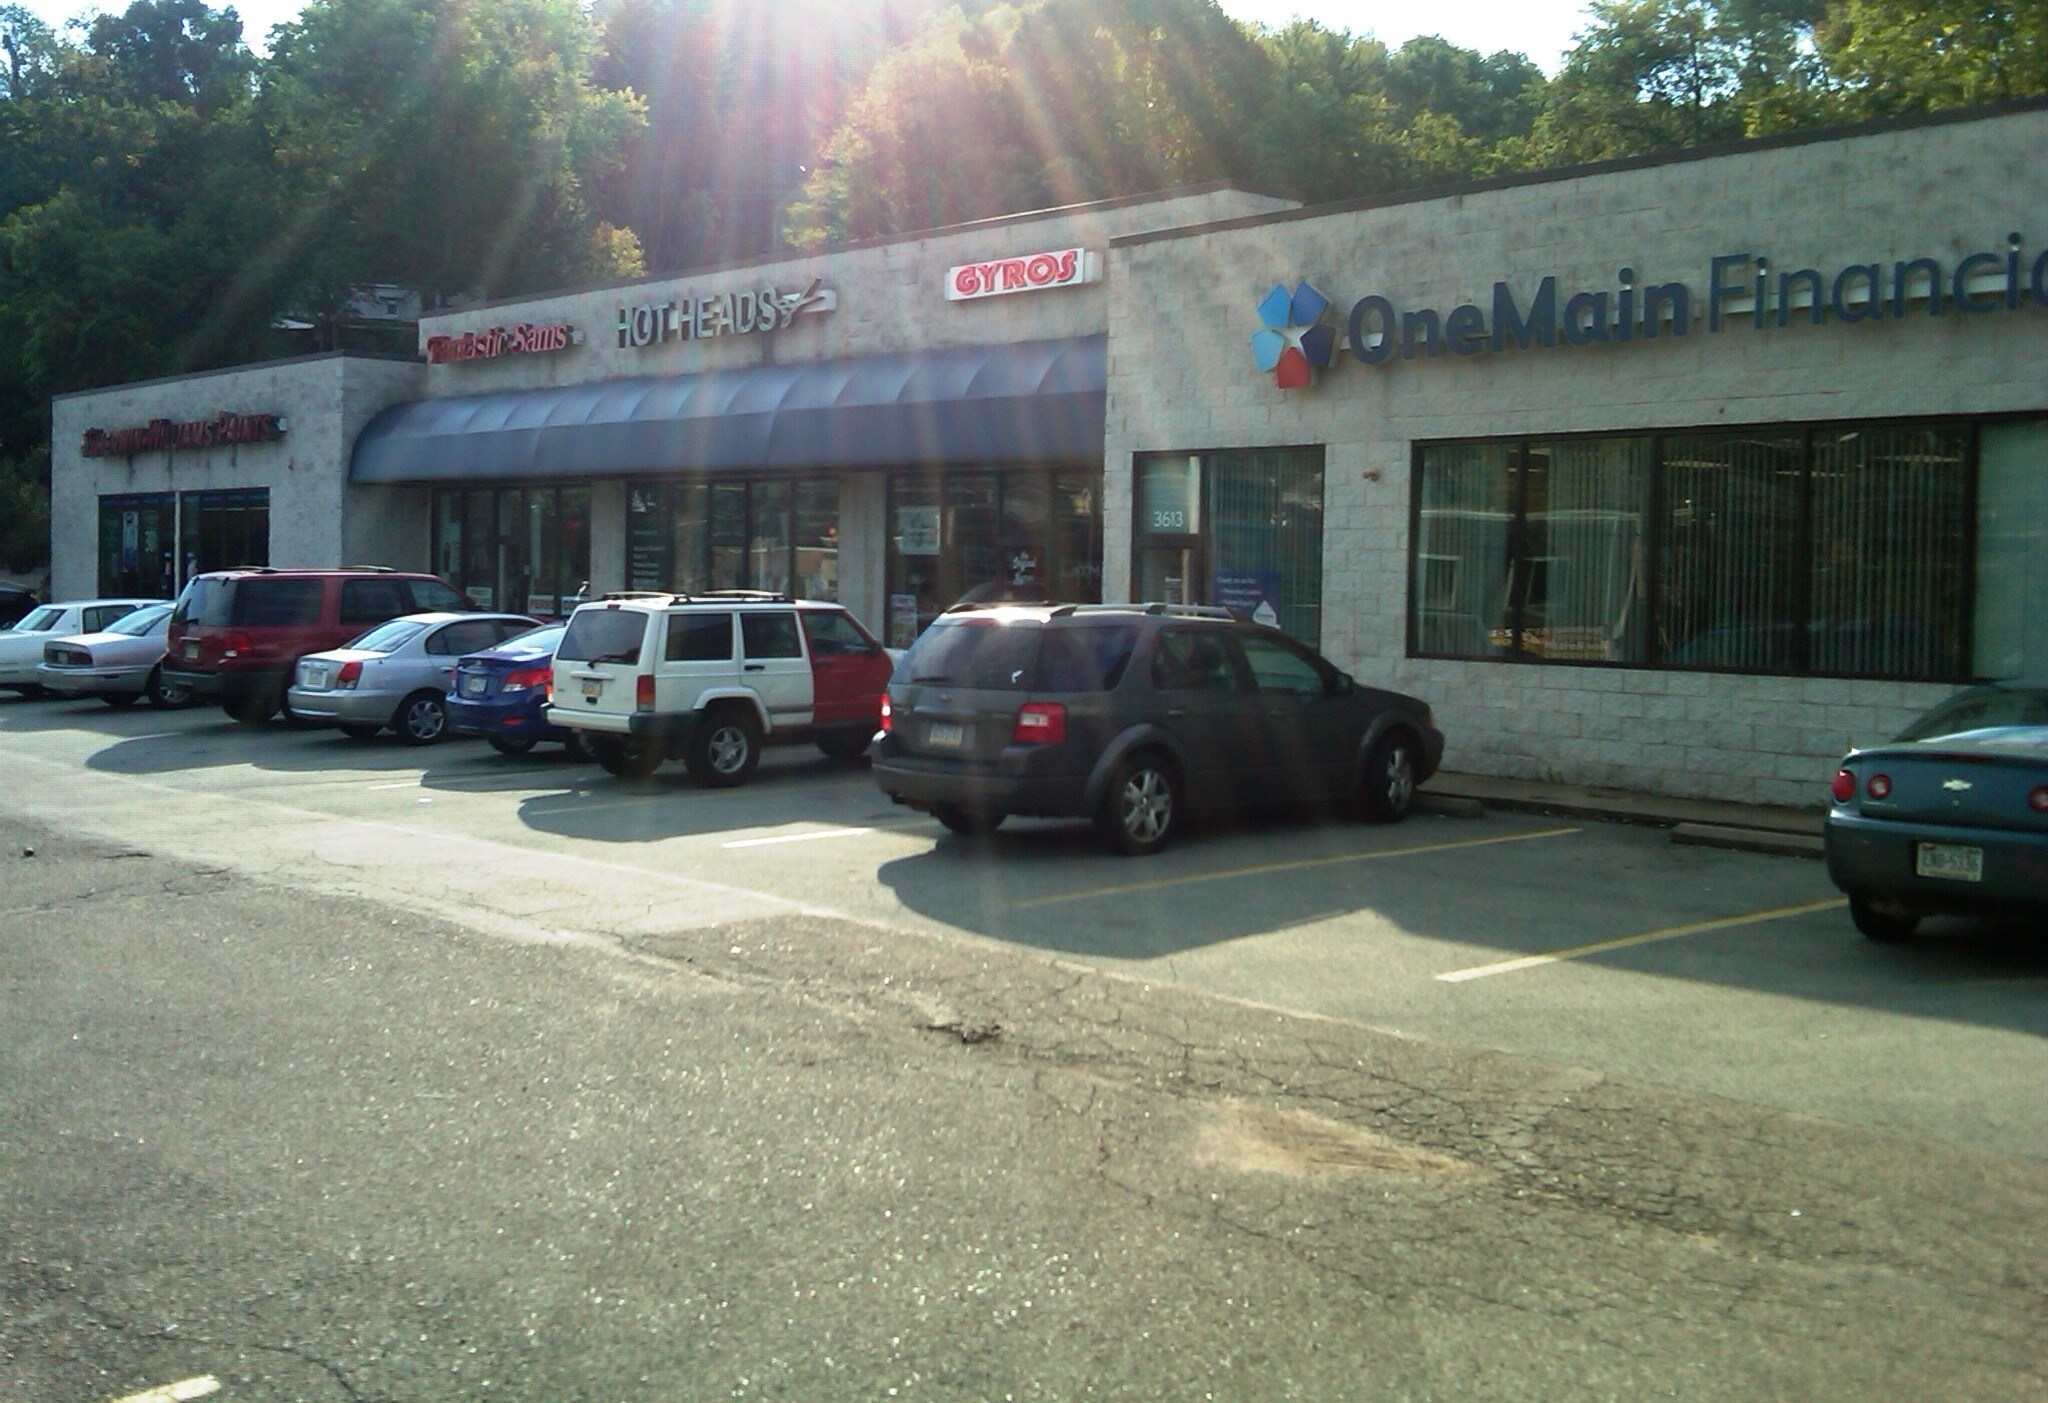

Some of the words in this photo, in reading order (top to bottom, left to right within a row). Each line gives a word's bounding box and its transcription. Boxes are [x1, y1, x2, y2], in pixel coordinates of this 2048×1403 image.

[956, 250, 1077, 295] GYROS
[512, 322, 568, 354] Sams
[617, 302, 671, 349] HOT
[676, 286, 778, 342] HEADS
[1348, 267, 1689, 365] OneMain
[1153, 511, 1184, 527] 3613
